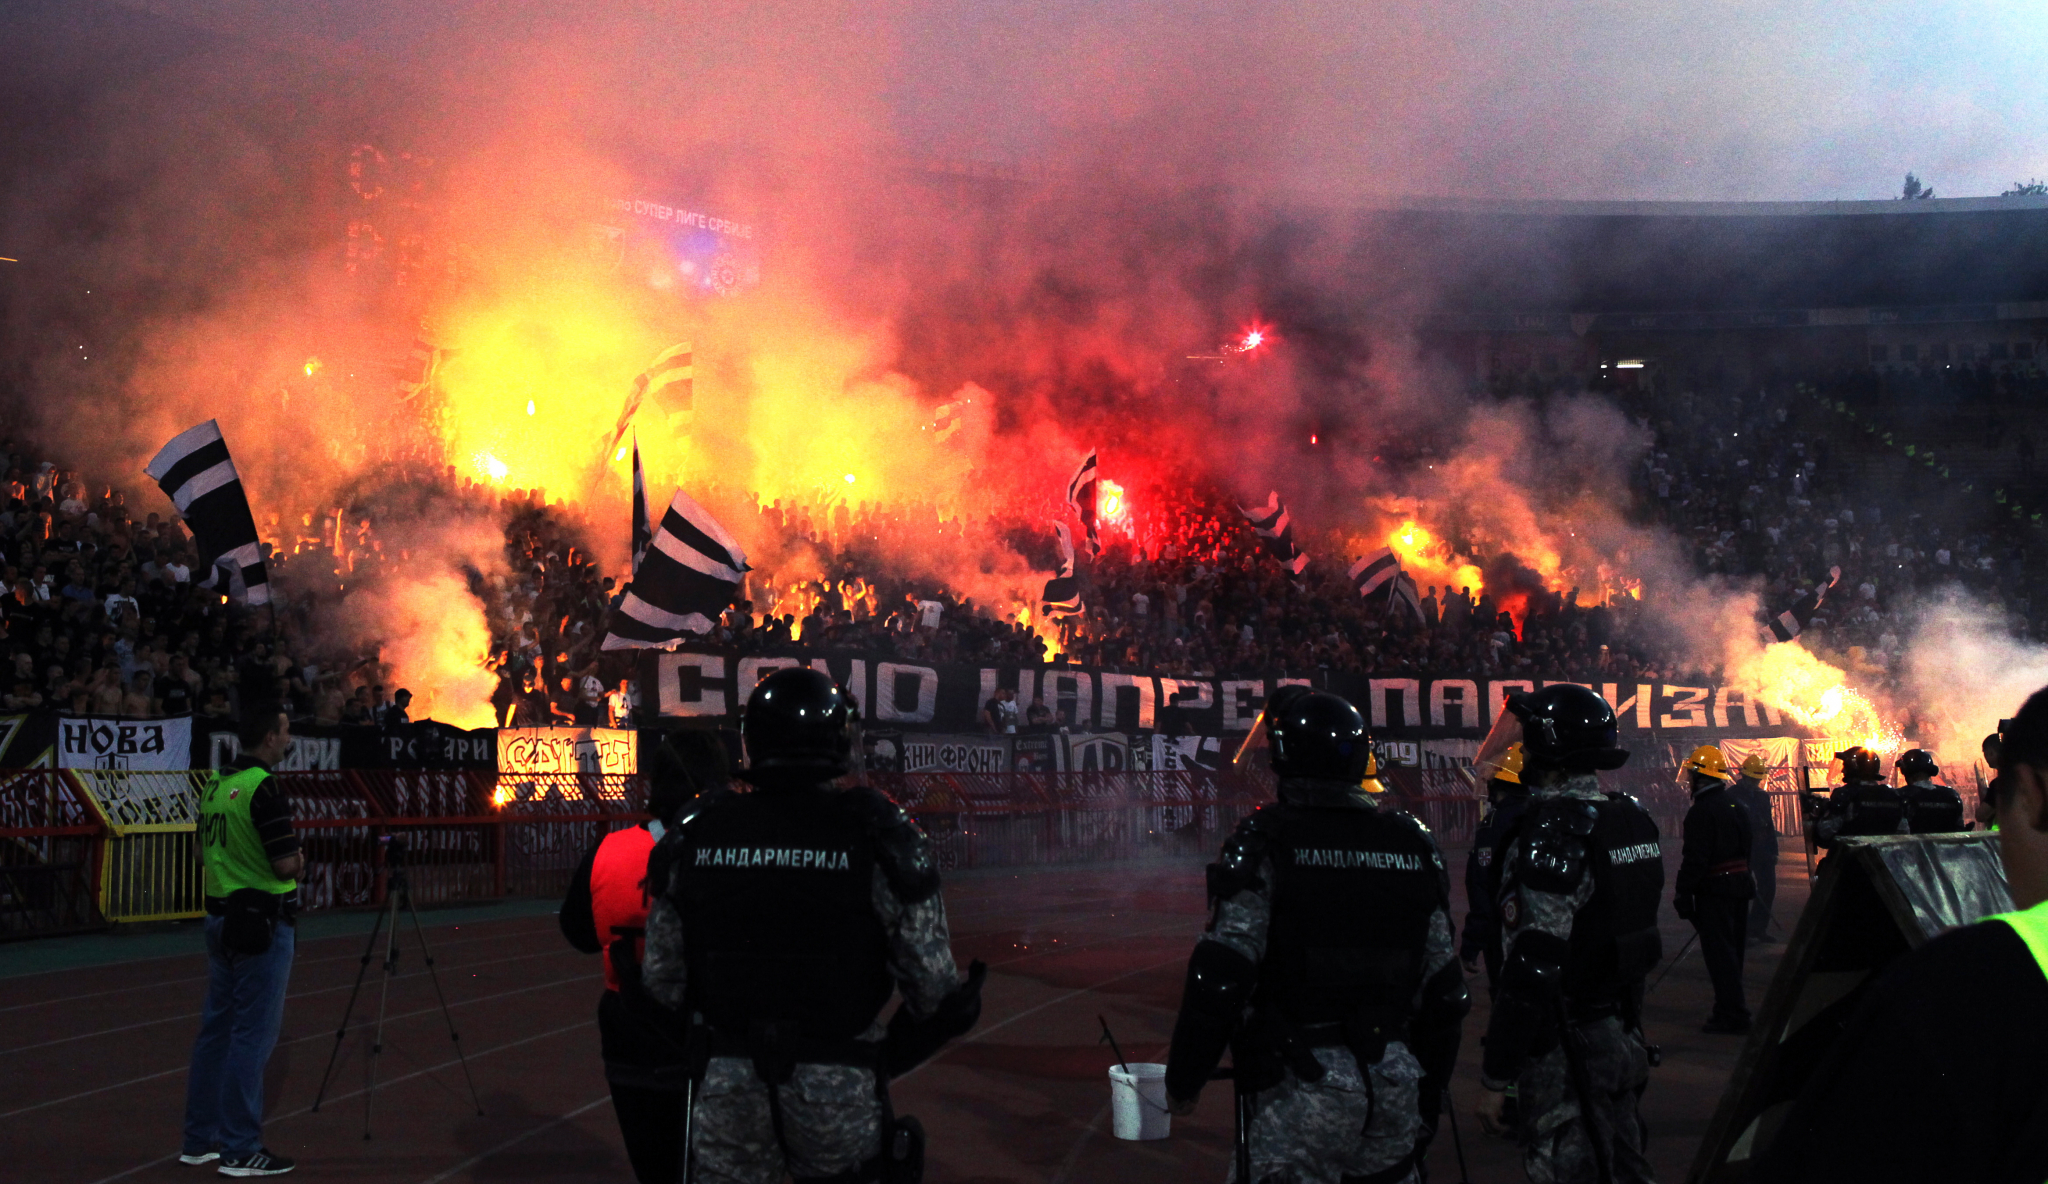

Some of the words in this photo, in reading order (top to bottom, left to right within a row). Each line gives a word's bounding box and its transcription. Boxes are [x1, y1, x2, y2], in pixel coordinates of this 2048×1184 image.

[634, 200, 673, 220] СУПЕР
[676, 209, 706, 229] ЛИГЕ
[708, 217, 752, 240] СРБИЈЕ
[975, 668, 1312, 731] НАПРЕ
[1369, 678, 1782, 728] ПАИЗА
[381, 736, 489, 760] РОАРИ
[940, 744, 1002, 776] ФРОНТ
[695, 848, 850, 870] ЖАНДАРМЕРИЈА
[1294, 848, 1424, 871] ЖАНДАРМЕРИЈА
